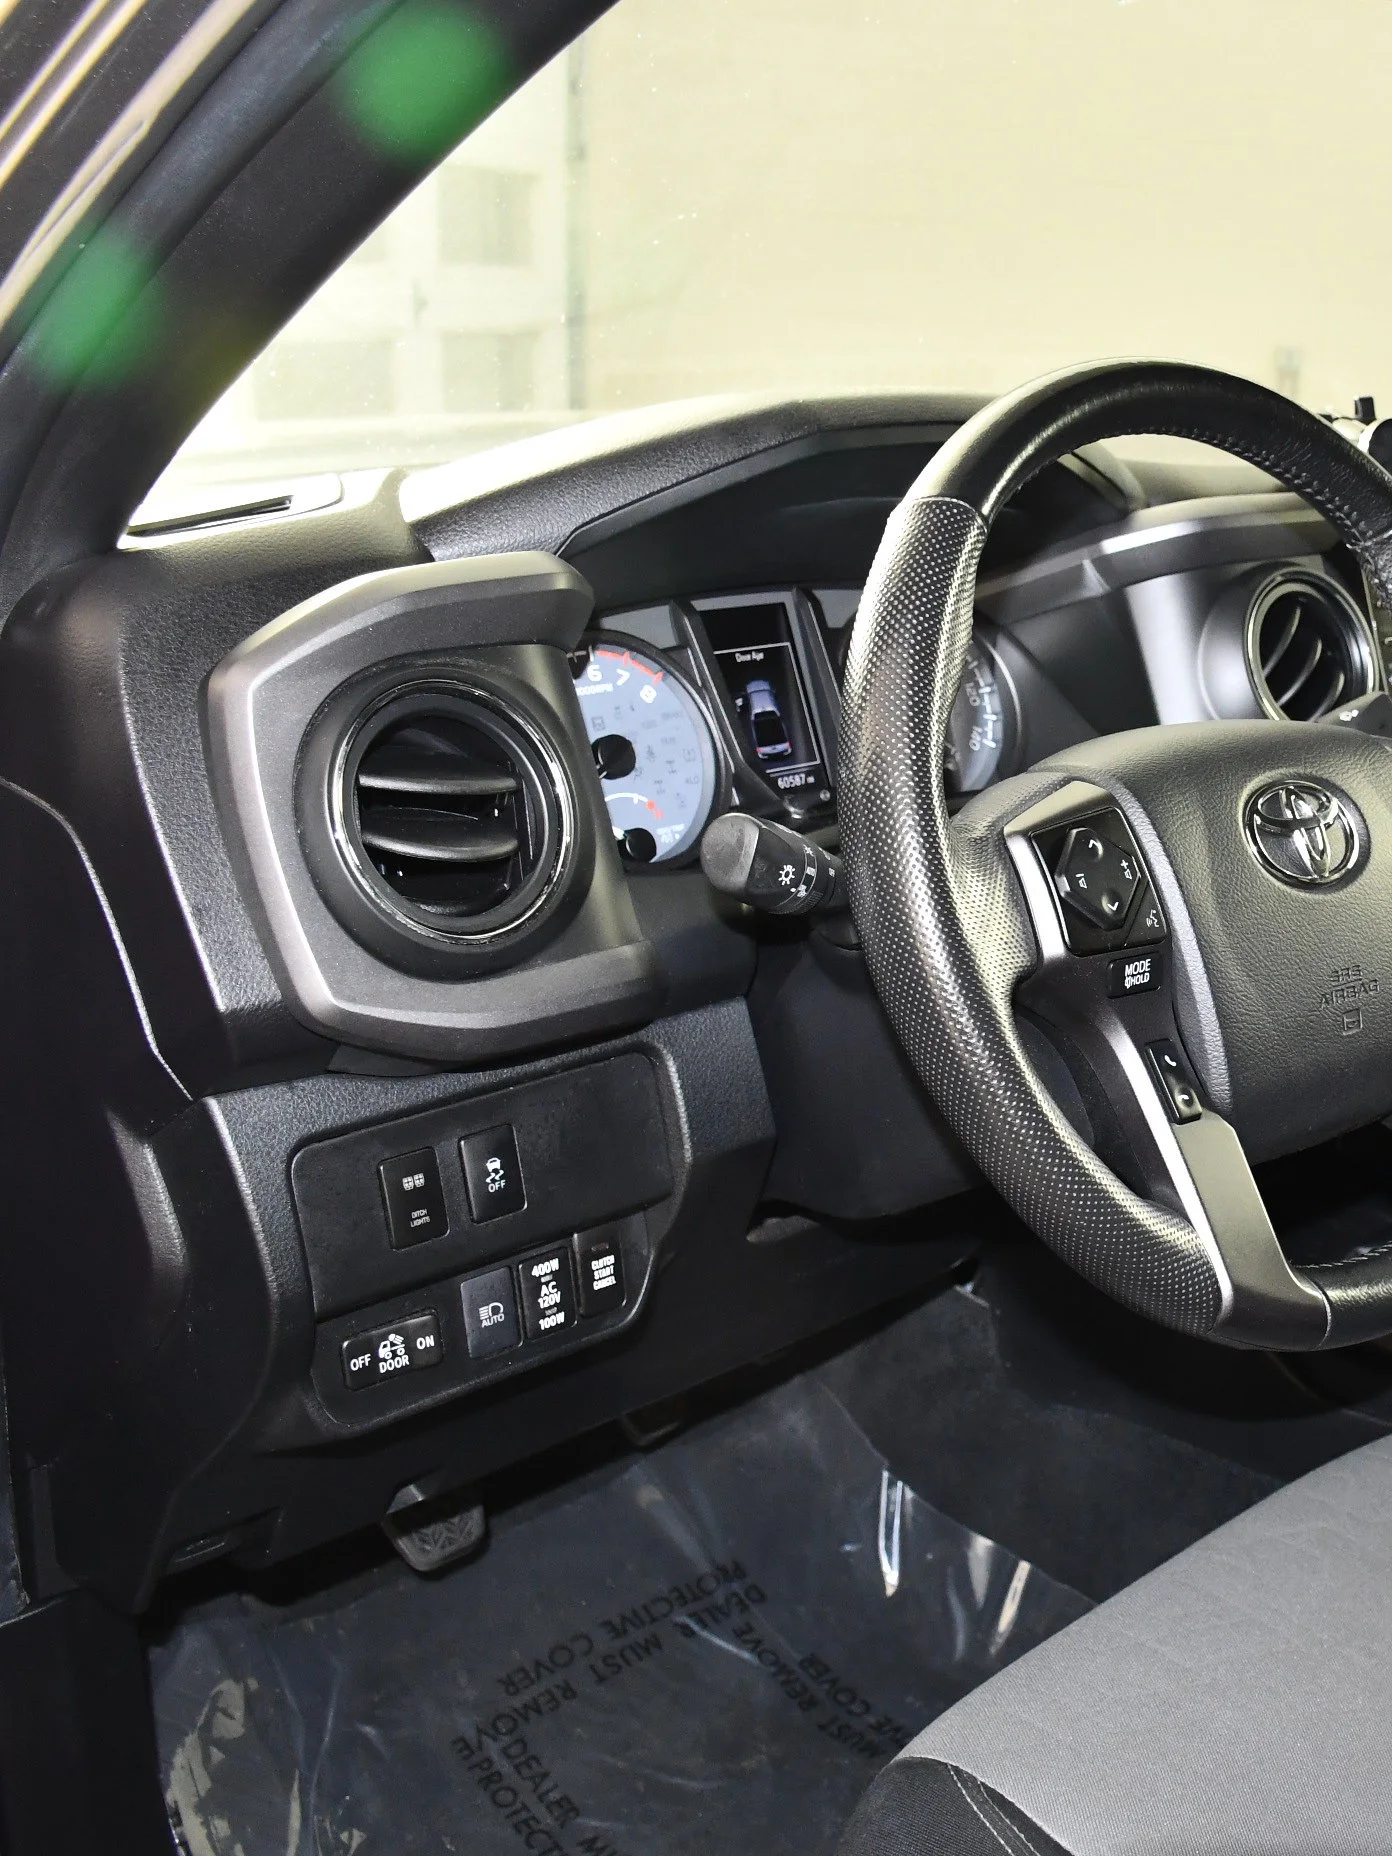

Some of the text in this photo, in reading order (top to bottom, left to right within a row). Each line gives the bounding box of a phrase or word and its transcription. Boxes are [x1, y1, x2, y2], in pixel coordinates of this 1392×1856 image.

[587, 664, 603, 682] 6
[616, 668, 630, 686] 7
[639, 684, 657, 704] 8
[1125, 959, 1151, 977] MODE
[1130, 972, 1150, 986] HOLD
[1320, 979, 1380, 1008] AIRBAG
[488, 1180, 506, 1193] OFF
[410, 1215, 430, 1228] LIGHTS
[531, 1258, 559, 1277] 400W
[594, 1265, 614, 1280] START
[540, 1281, 558, 1297] AC
[537, 1291, 561, 1309] 120V
[481, 1313, 505, 1329] AUTO
[539, 1311, 565, 1331] 100W
[416, 1335, 435, 1350] ON
[350, 1353, 371, 1371] OFF
[379, 1354, 410, 1374] DOOR
[497, 1632, 594, 1697] COVER
[588, 1632, 663, 1685] MUST
[500, 1738, 580, 1829] DEALER
